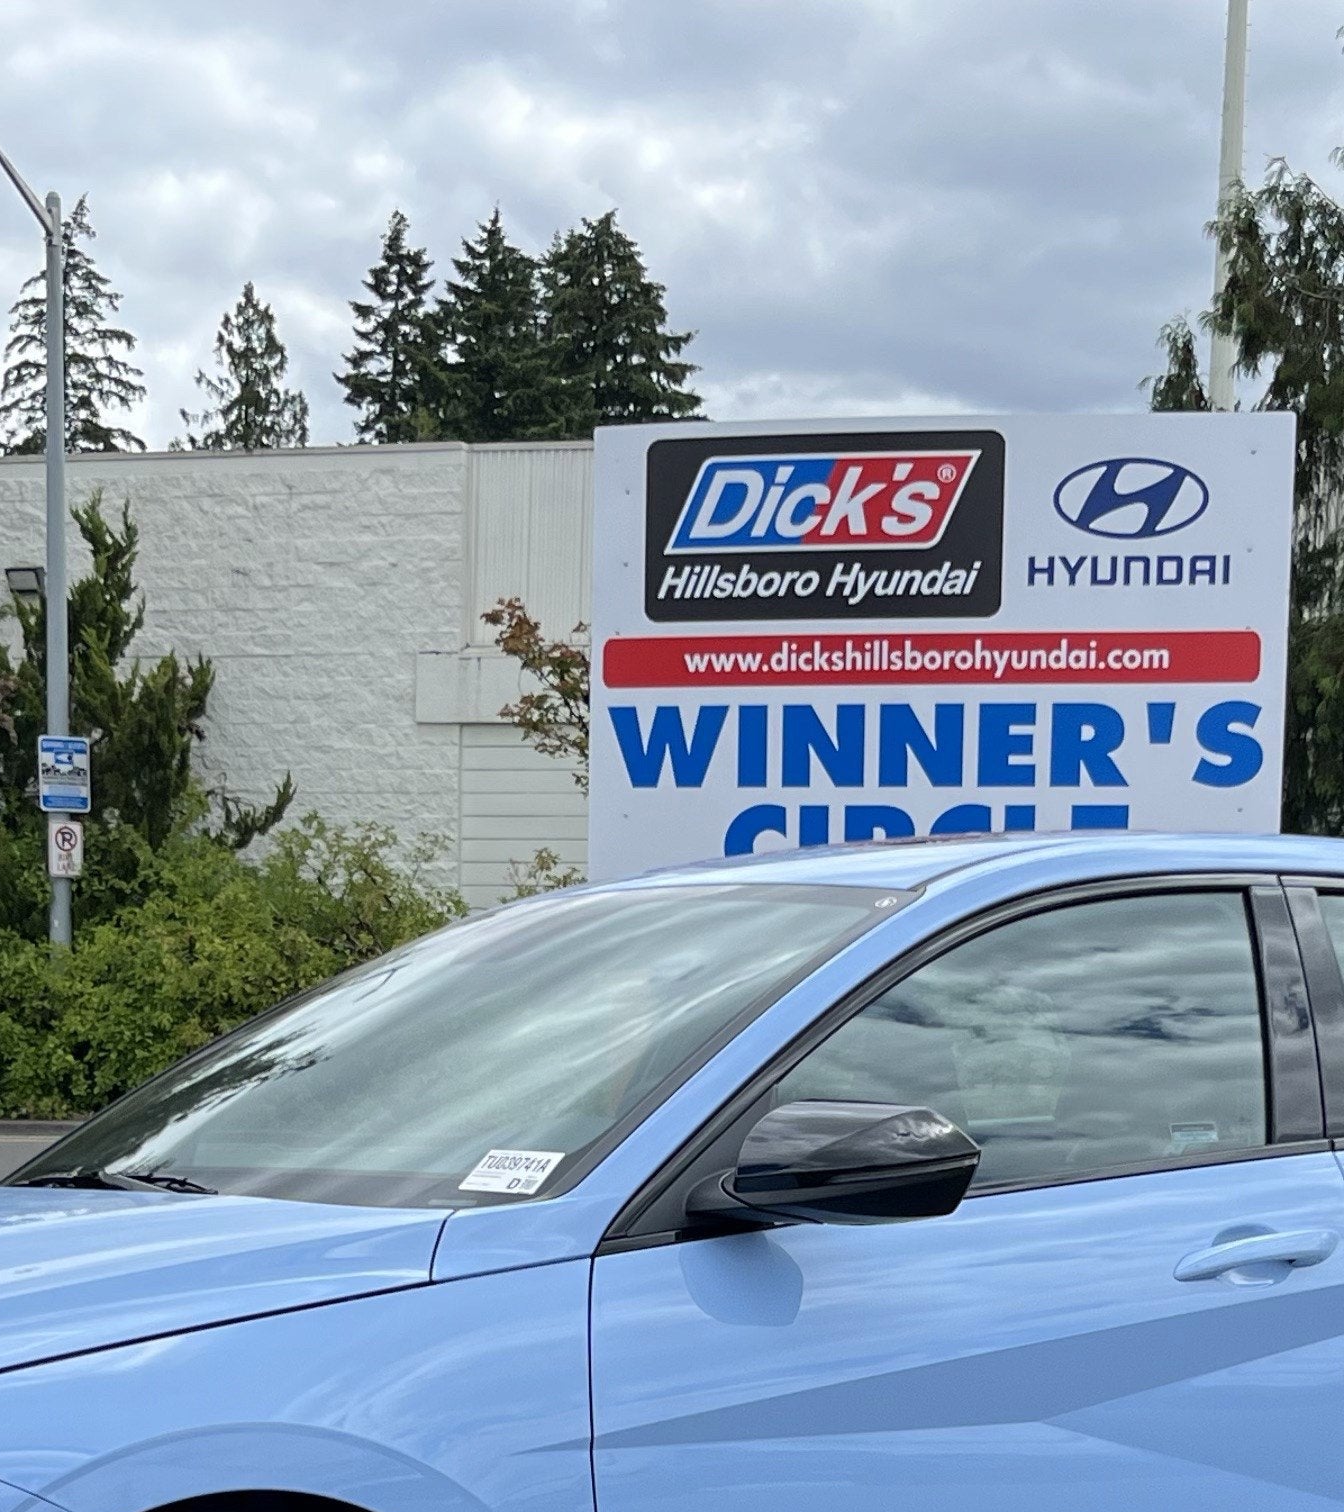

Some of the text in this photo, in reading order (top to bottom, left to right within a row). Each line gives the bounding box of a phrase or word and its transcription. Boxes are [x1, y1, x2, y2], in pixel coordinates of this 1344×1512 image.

[687, 462, 941, 540] Dick's
[658, 561, 982, 604] Hillsboro Hyundai
[1029, 554, 1231, 587] HYUNDAI
[684, 639, 1170, 679] www.dickshillsborohyundai.com
[608, 698, 1265, 790] WINNER'S
